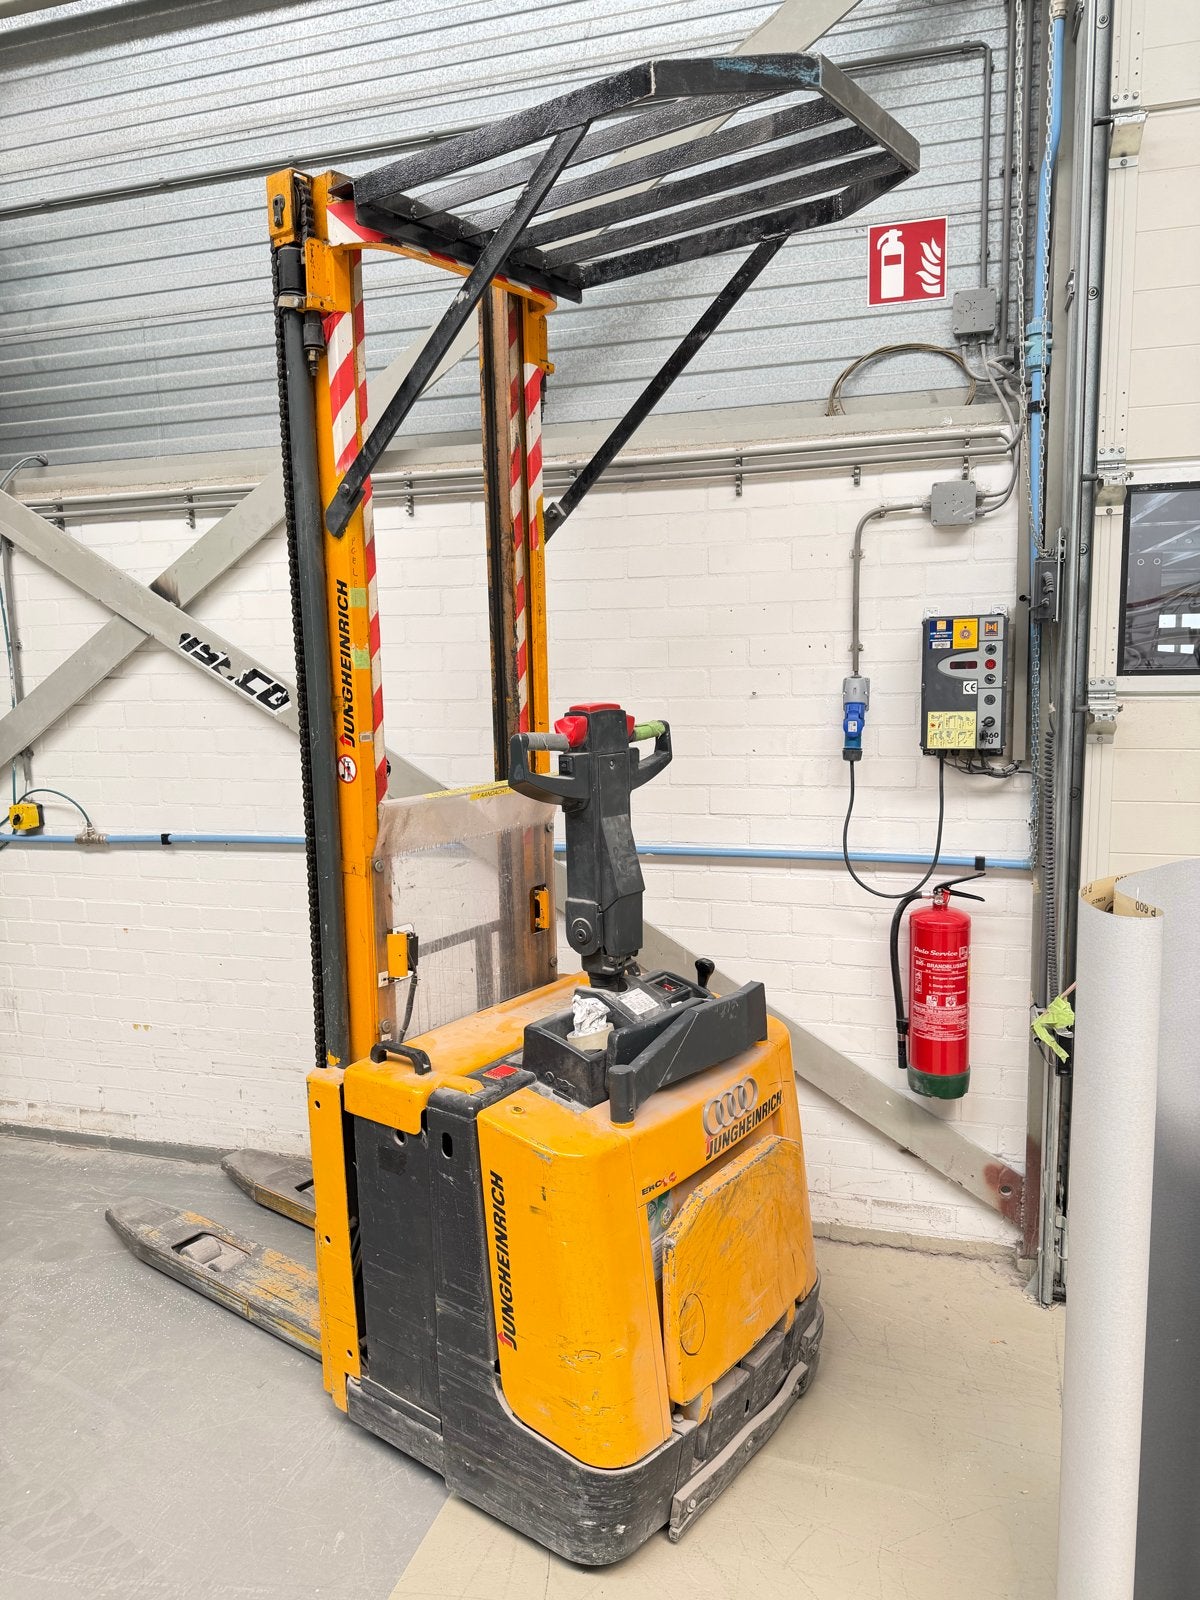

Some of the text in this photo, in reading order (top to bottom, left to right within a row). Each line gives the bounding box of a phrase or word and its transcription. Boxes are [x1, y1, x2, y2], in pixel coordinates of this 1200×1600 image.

[336, 579, 355, 748] JUNGHEINRICH
[706, 1089, 782, 1161] JUNGHEINRICH
[490, 1170, 518, 1351] JUNGHEINRICH
